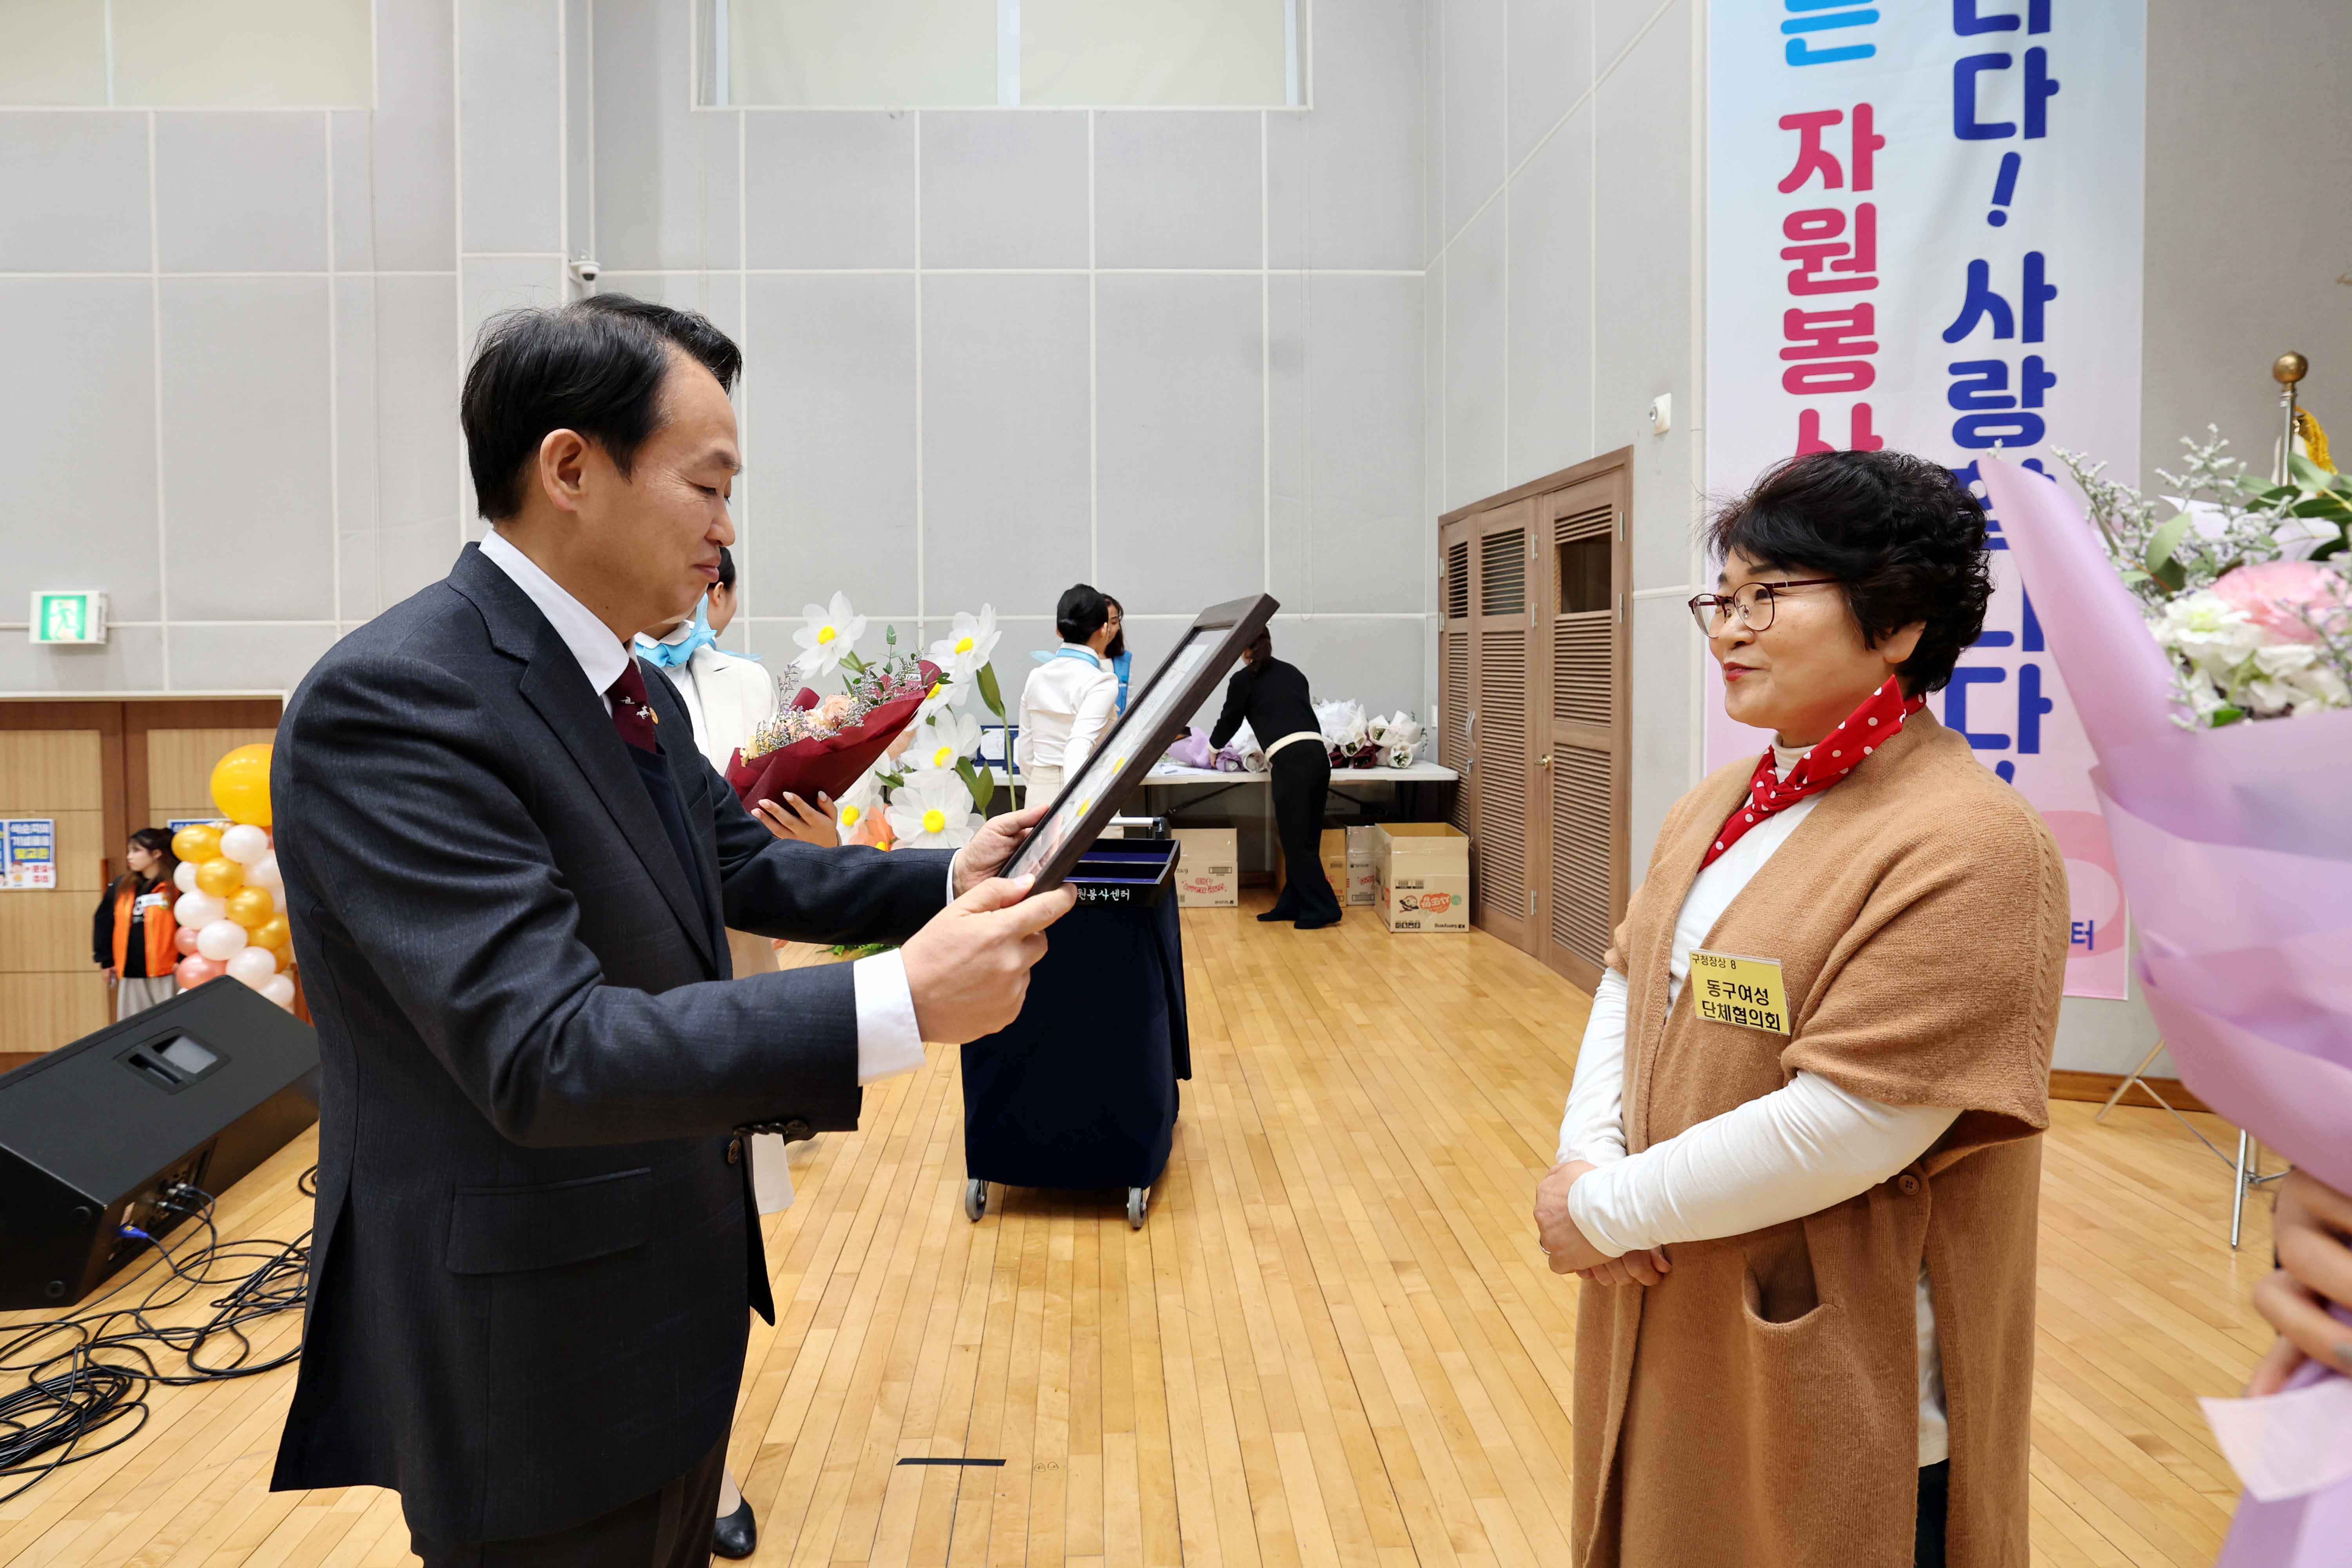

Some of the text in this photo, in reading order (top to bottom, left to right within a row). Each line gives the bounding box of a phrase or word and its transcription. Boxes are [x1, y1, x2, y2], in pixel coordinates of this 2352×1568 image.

[1692, 954, 1736, 969] 구청장상 8
[1707, 979, 1769, 1006] 동구여성
[1702, 1000, 1780, 1031] 단체협의회
